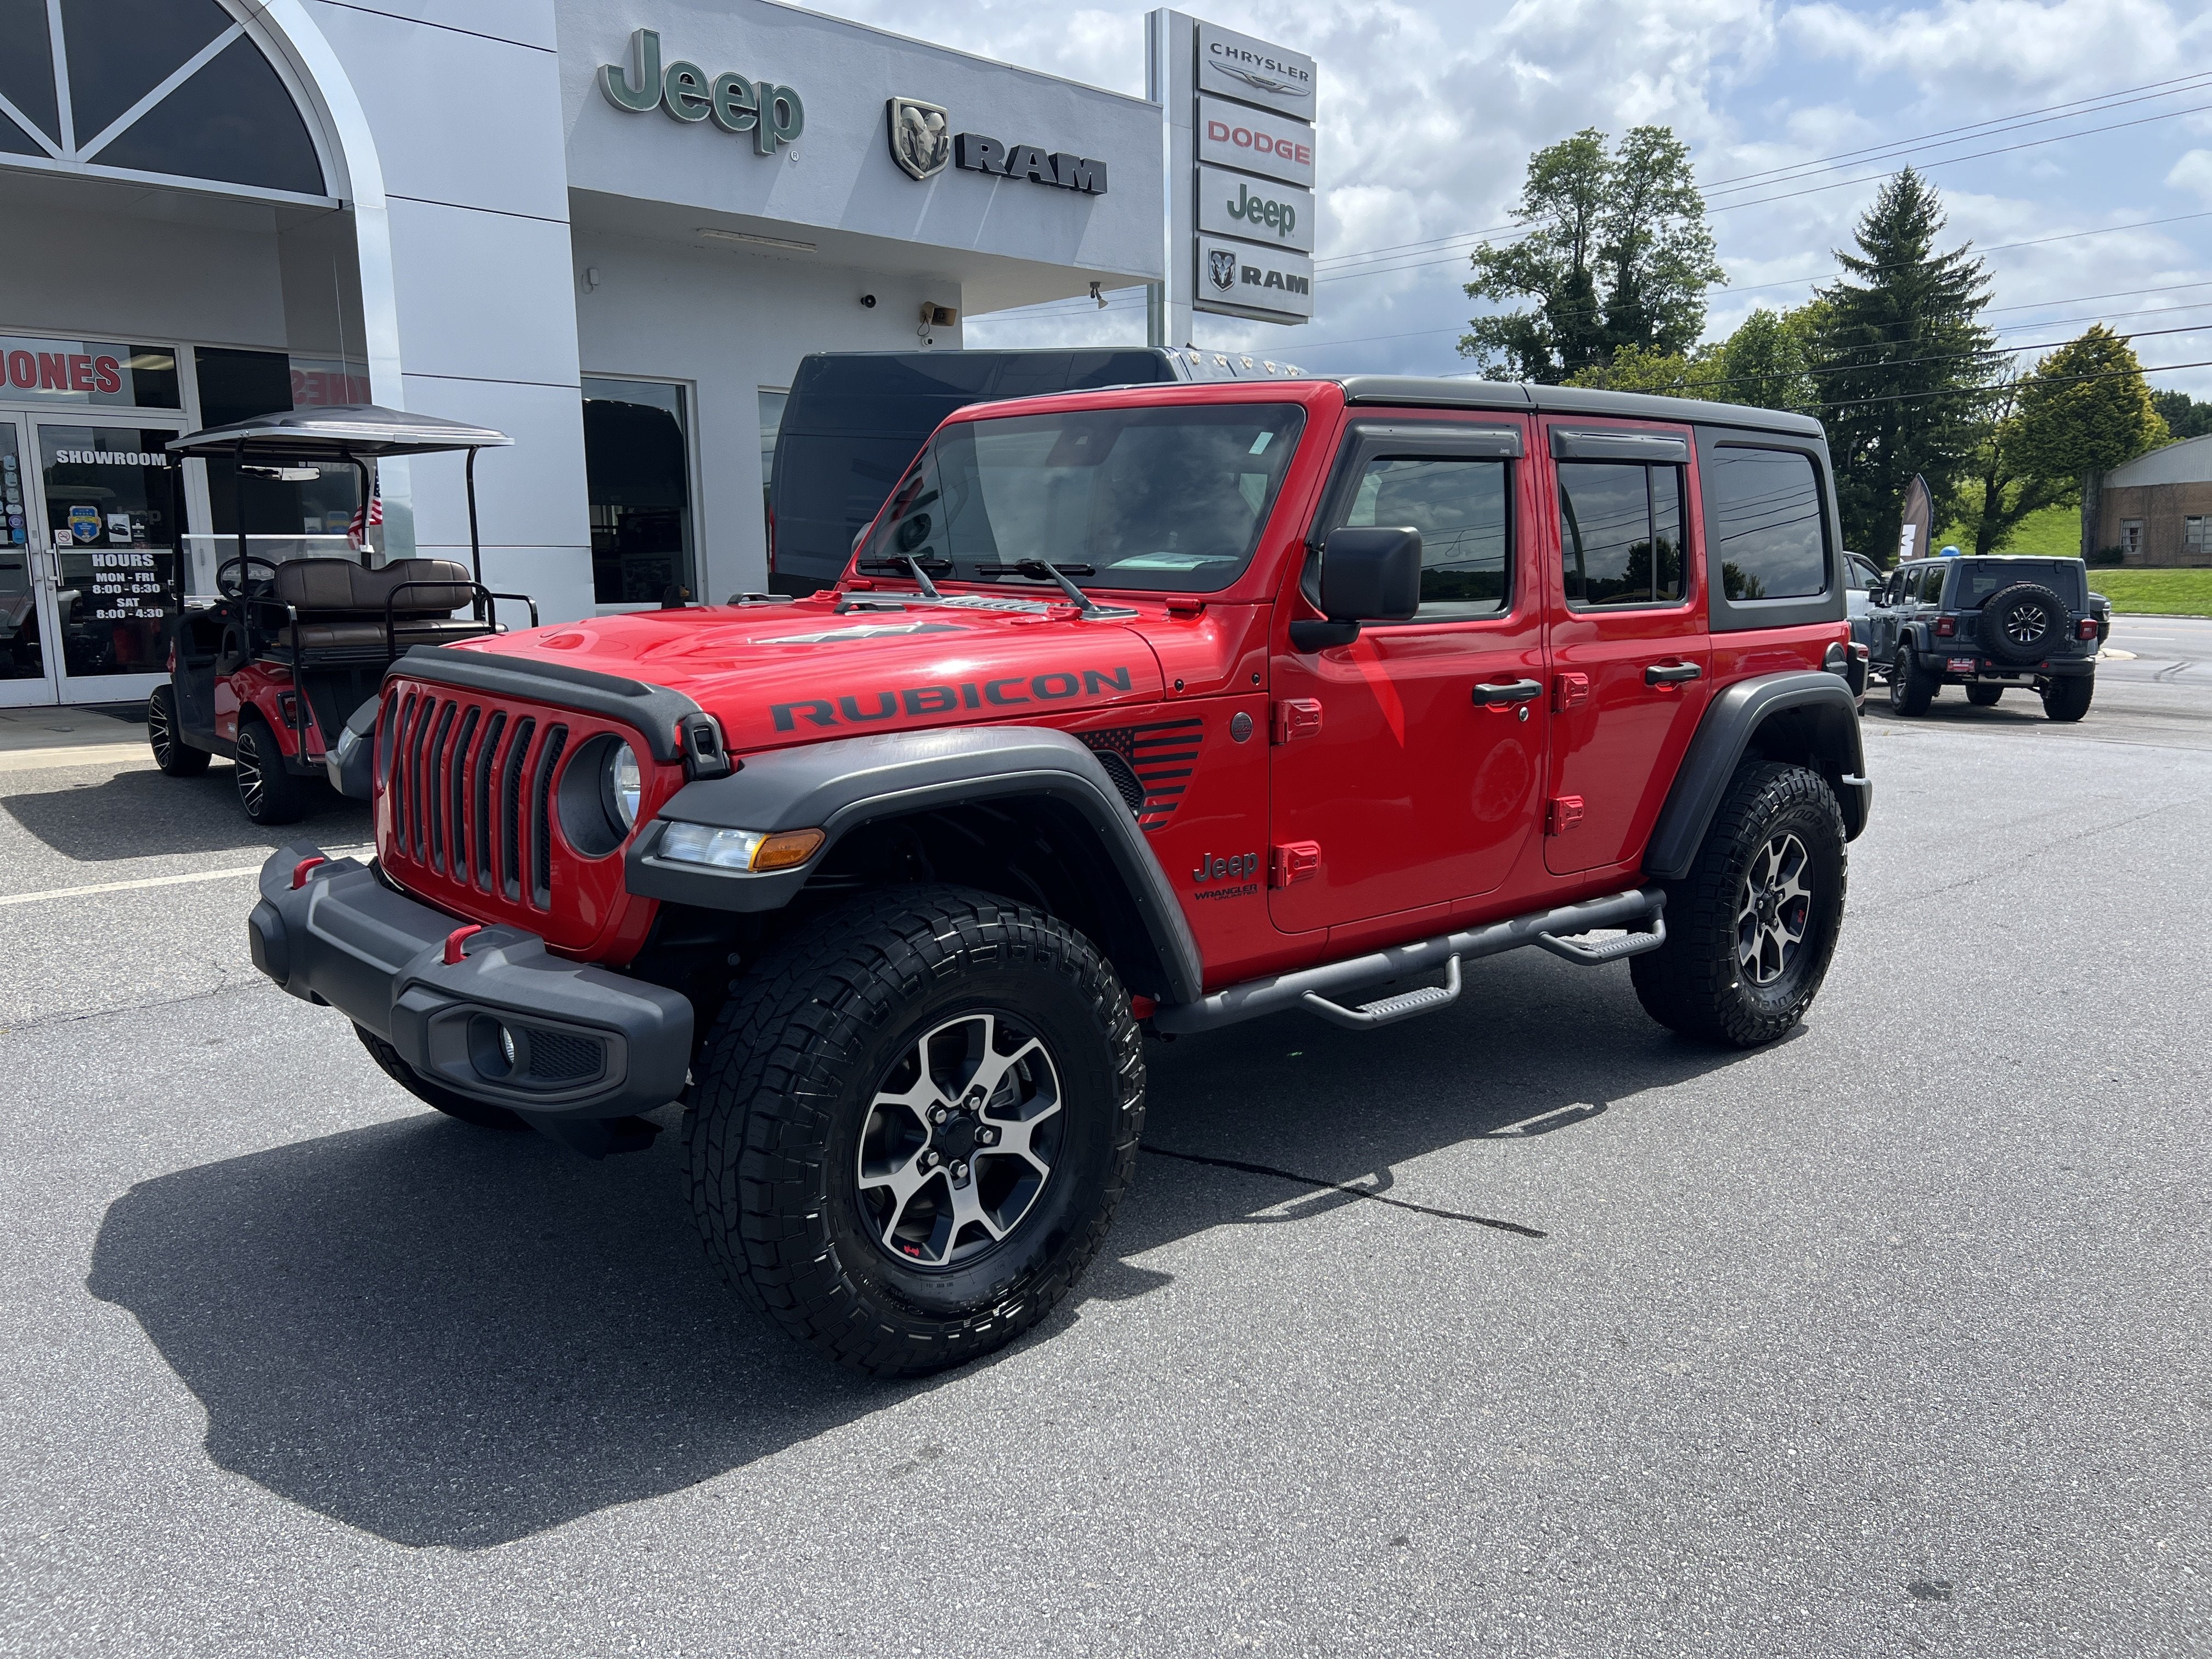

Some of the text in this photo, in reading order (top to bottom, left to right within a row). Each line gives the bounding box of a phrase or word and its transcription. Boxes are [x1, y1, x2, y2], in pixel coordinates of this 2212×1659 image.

[1210, 42, 1310, 82] CHRYSLER
[598, 28, 805, 155] Jeep
[1208, 120, 1311, 166] DODGE
[955, 132, 1108, 195] RAM
[1227, 183, 1296, 236] Jeep
[1241, 265, 1309, 296] RAM
[0, 349, 122, 394] ONES
[56, 450, 167, 466] SHOWROOM
[92, 554, 154, 567] HOURS
[92, 584, 121, 594] 8:00
[132, 584, 160, 594] 6:30
[95, 572, 125, 582] MON
[136, 572, 155, 582] FRI
[96, 610, 126, 619] 8:00
[136, 608, 163, 618] 4:30
[116, 598, 140, 607] SAT
[770, 667, 1133, 733] RUBICON
[1193, 853, 1259, 882] Jeep
[1194, 884, 1257, 900] WRANGLER
[1214, 891, 1258, 901] UNLIMITED
